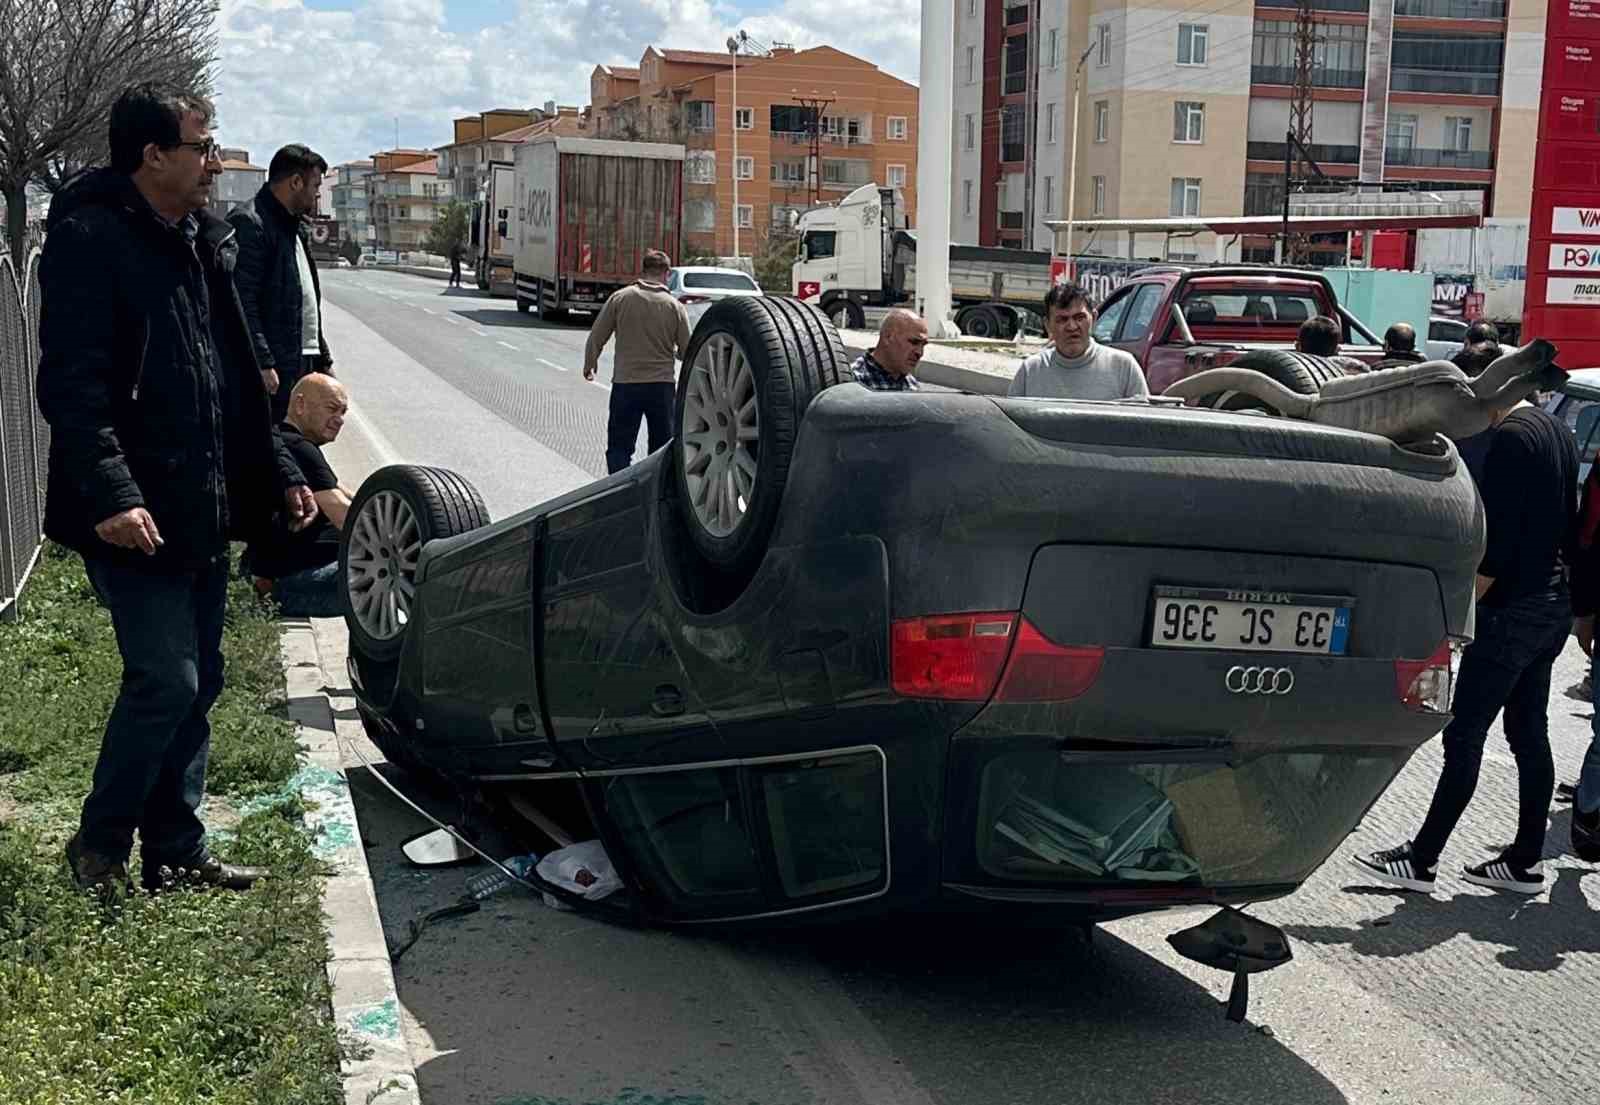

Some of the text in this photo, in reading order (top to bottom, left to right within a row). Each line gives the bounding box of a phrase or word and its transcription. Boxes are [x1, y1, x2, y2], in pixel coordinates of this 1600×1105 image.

[1163, 603, 1329, 648] 33 SC 336
